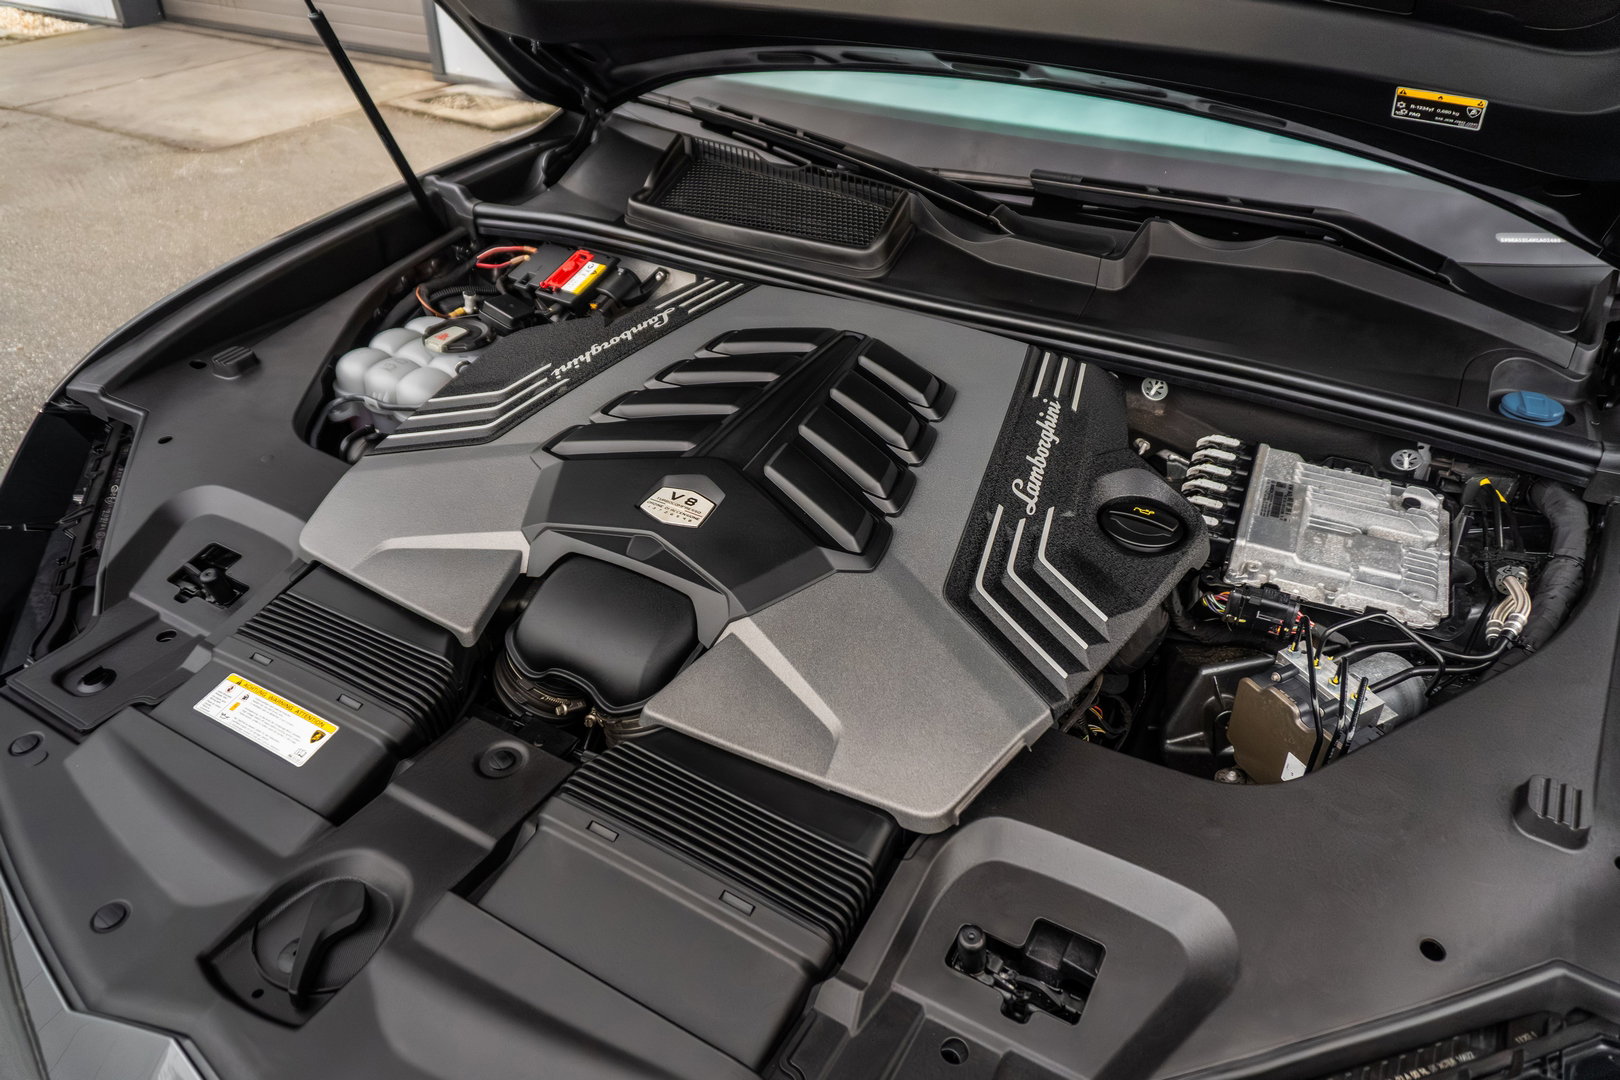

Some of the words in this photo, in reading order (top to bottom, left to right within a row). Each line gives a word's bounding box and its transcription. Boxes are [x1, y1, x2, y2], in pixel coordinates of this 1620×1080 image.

[551, 307, 675, 379] Lamborghini
[1012, 398, 1061, 515] Lamborghini
[268, 695, 294, 711] WARNING
[295, 709, 325, 727] ATTENTION
